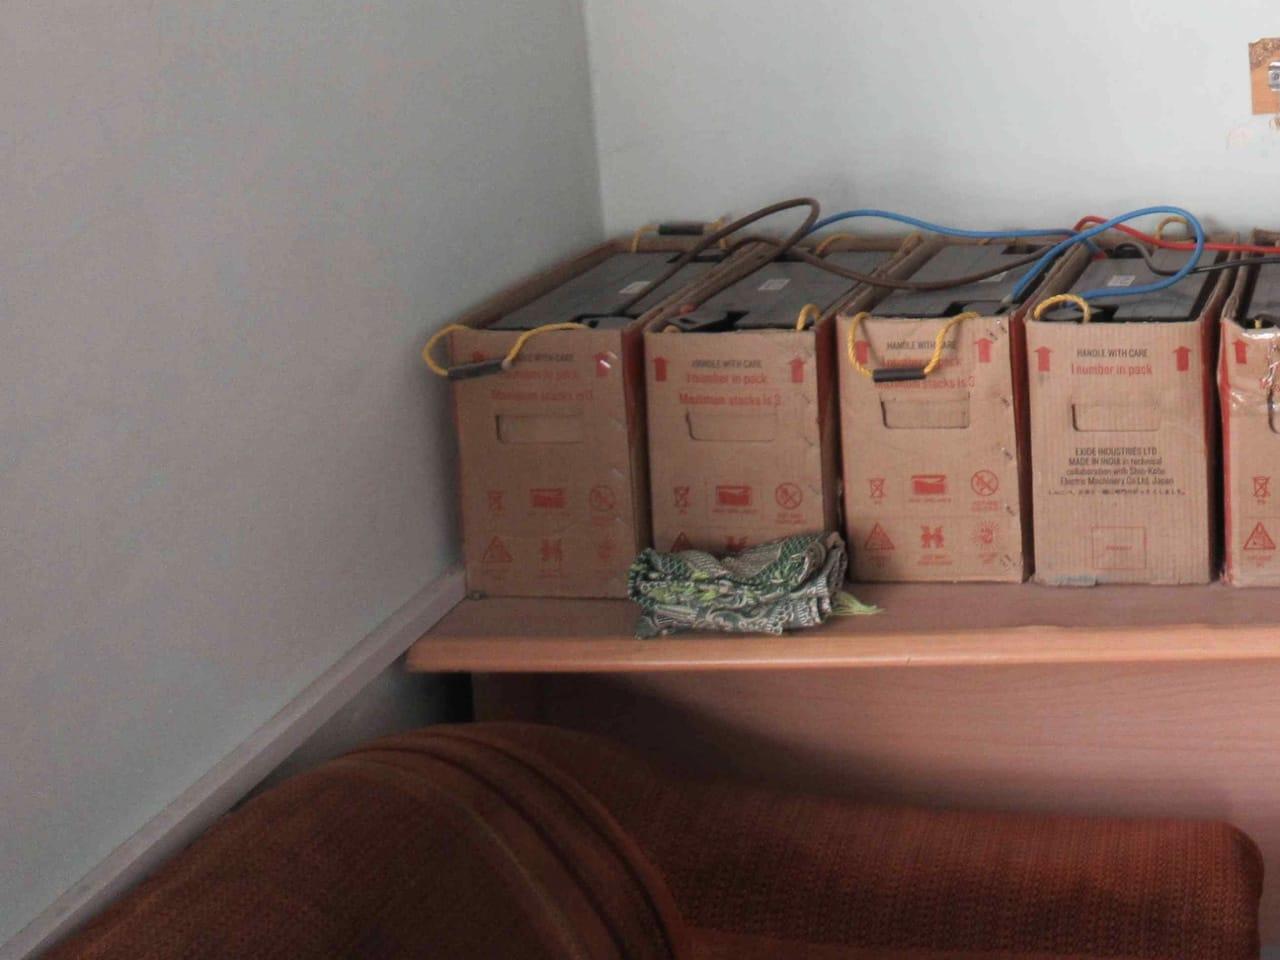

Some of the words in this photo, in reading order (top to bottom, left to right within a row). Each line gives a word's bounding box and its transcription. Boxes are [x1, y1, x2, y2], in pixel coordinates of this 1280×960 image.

[1076, 348, 1105, 358] HANDLE
[1107, 348, 1127, 358] WITH
[1128, 348, 1148, 358] CARE
[1076, 363, 1114, 375] number
[1116, 364, 1126, 374] in
[1128, 362, 1152, 377] pack
[1075, 447, 1097, 456] EXIDE
[1098, 447, 1141, 456] INDUSTRIES
[1143, 447, 1158, 456] LTD
[1068, 457, 1088, 465] MADE
[1091, 457, 1099, 465] IN
[1101, 457, 1120, 465] INDIA
[1066, 467, 1112, 476] collaboration
[1088, 476, 1125, 486] Machinery
